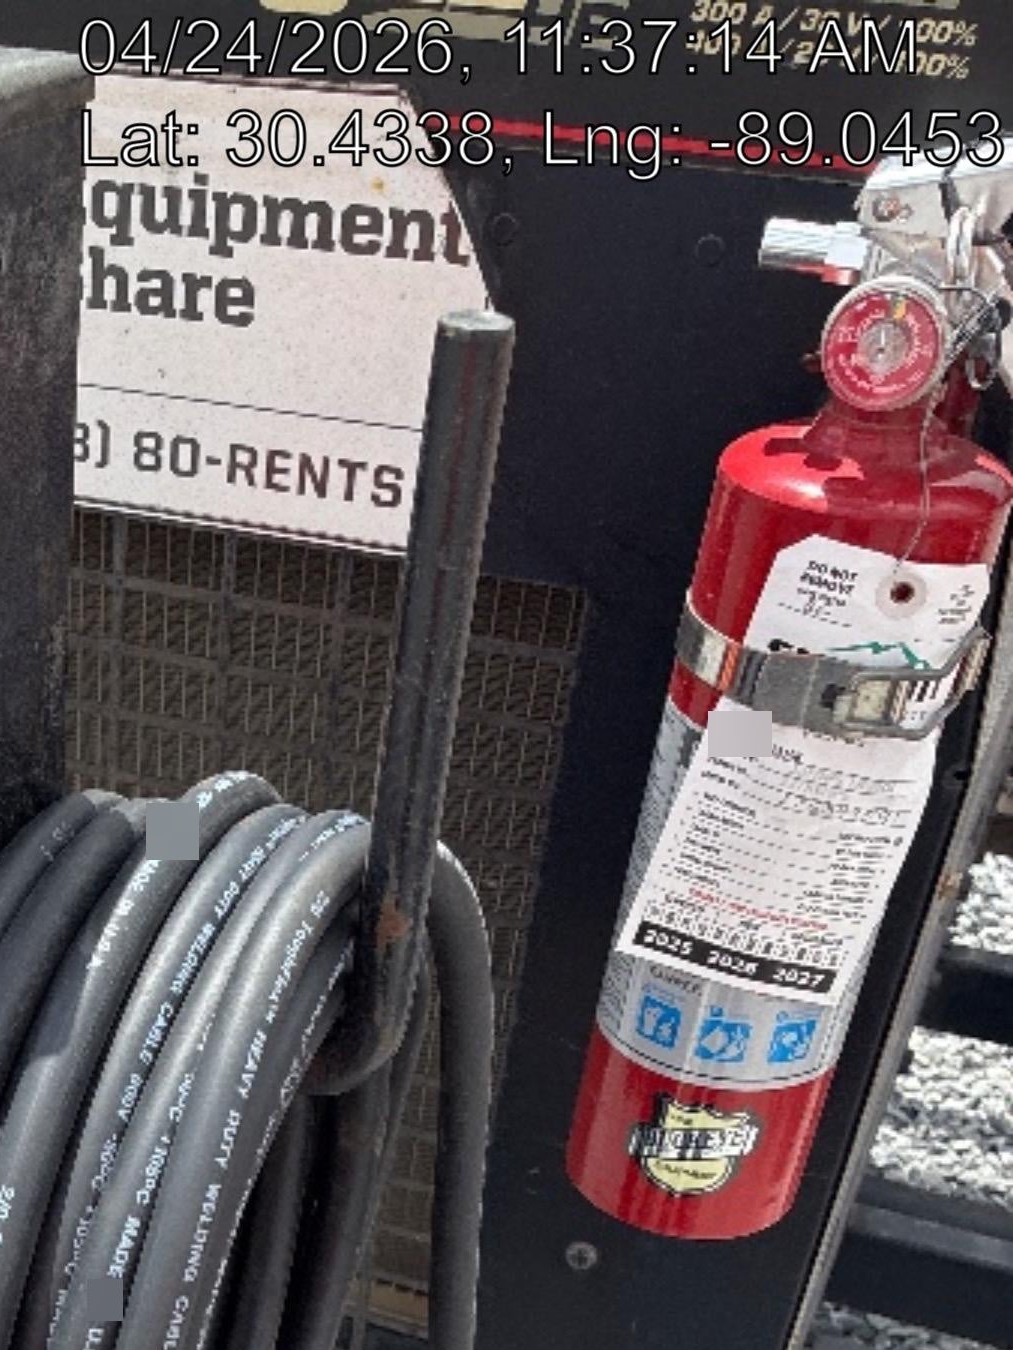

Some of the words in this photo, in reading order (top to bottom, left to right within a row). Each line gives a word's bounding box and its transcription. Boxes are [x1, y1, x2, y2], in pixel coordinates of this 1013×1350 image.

[896, 17, 979, 47] 00%
[82, 172, 470, 267] quipment
[83, 245, 255, 328] hare
[132, 430, 405, 509] 80-RENTS
[771, 966, 826, 988] 2027
[139, 1000, 175, 1066] CABLE
[237, 1027, 268, 1100] HEAVY
[213, 1109, 243, 1170] DUTY
[106, 1214, 142, 1279] MADE
[182, 1182, 224, 1284] WELDING
